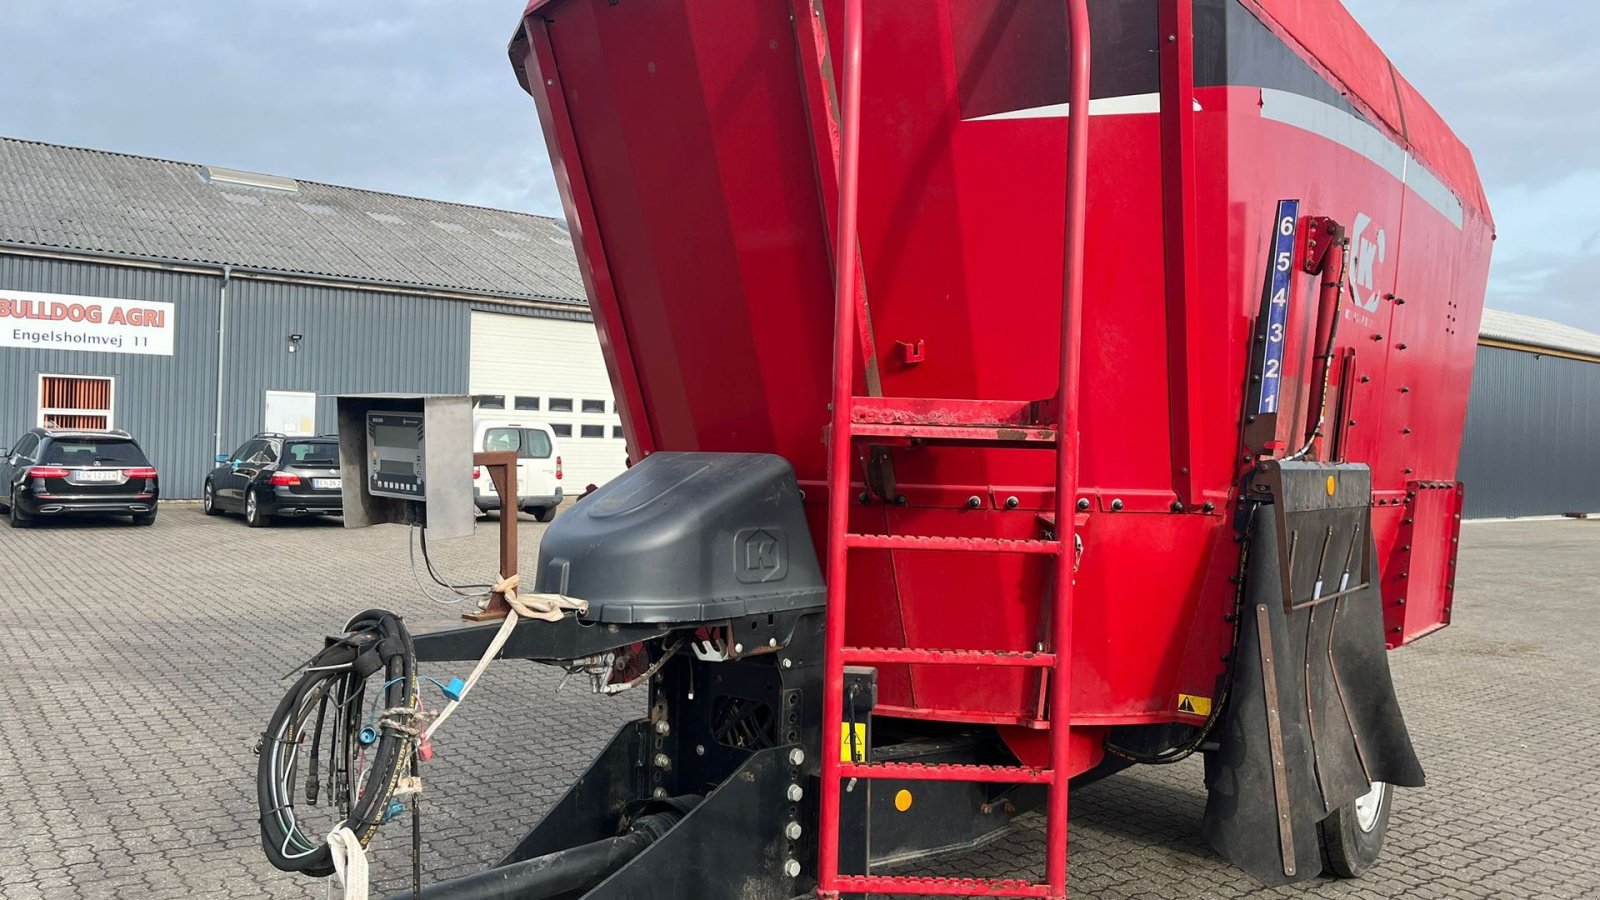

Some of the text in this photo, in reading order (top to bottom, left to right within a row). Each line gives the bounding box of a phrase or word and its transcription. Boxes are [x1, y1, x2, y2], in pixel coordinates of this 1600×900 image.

[1280, 216, 1294, 236] 6
[1277, 252, 1291, 272] 5
[1272, 287, 1286, 307] 4
[0, 299, 165, 329] BULLDOG AGRI
[13, 329, 148, 348] Engelsholmvej 11
[1270, 323, 1283, 343] 3
[1265, 359, 1279, 378] 2
[1264, 394, 1276, 413] 1
